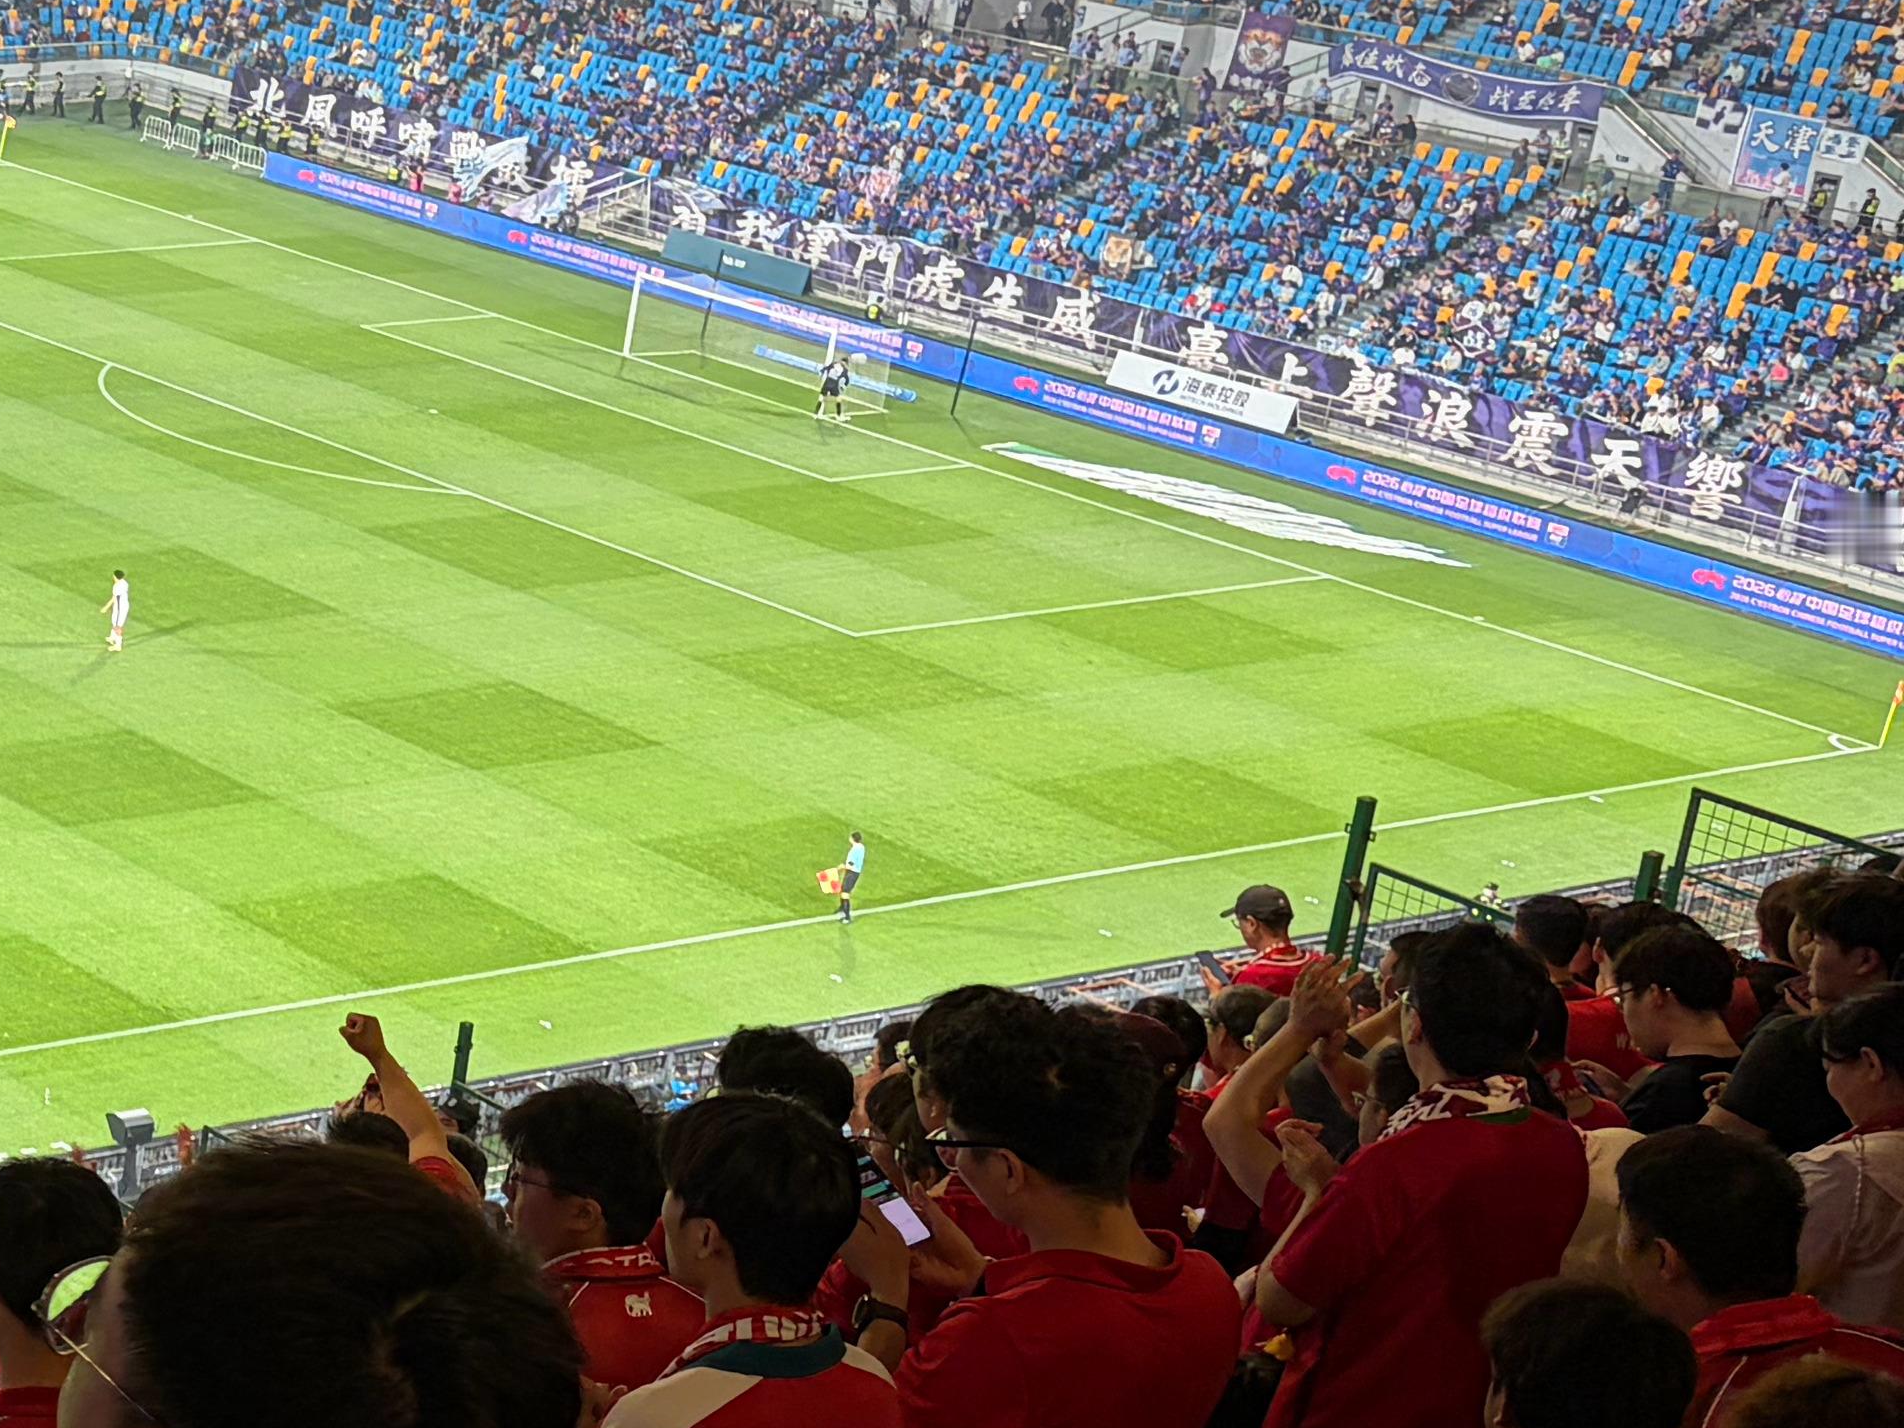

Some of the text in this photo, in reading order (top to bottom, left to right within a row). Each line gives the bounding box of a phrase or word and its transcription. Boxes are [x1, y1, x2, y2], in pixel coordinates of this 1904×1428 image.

[1751, 121, 1818, 160] 天津
[1183, 375, 1250, 408] 海泰控股
